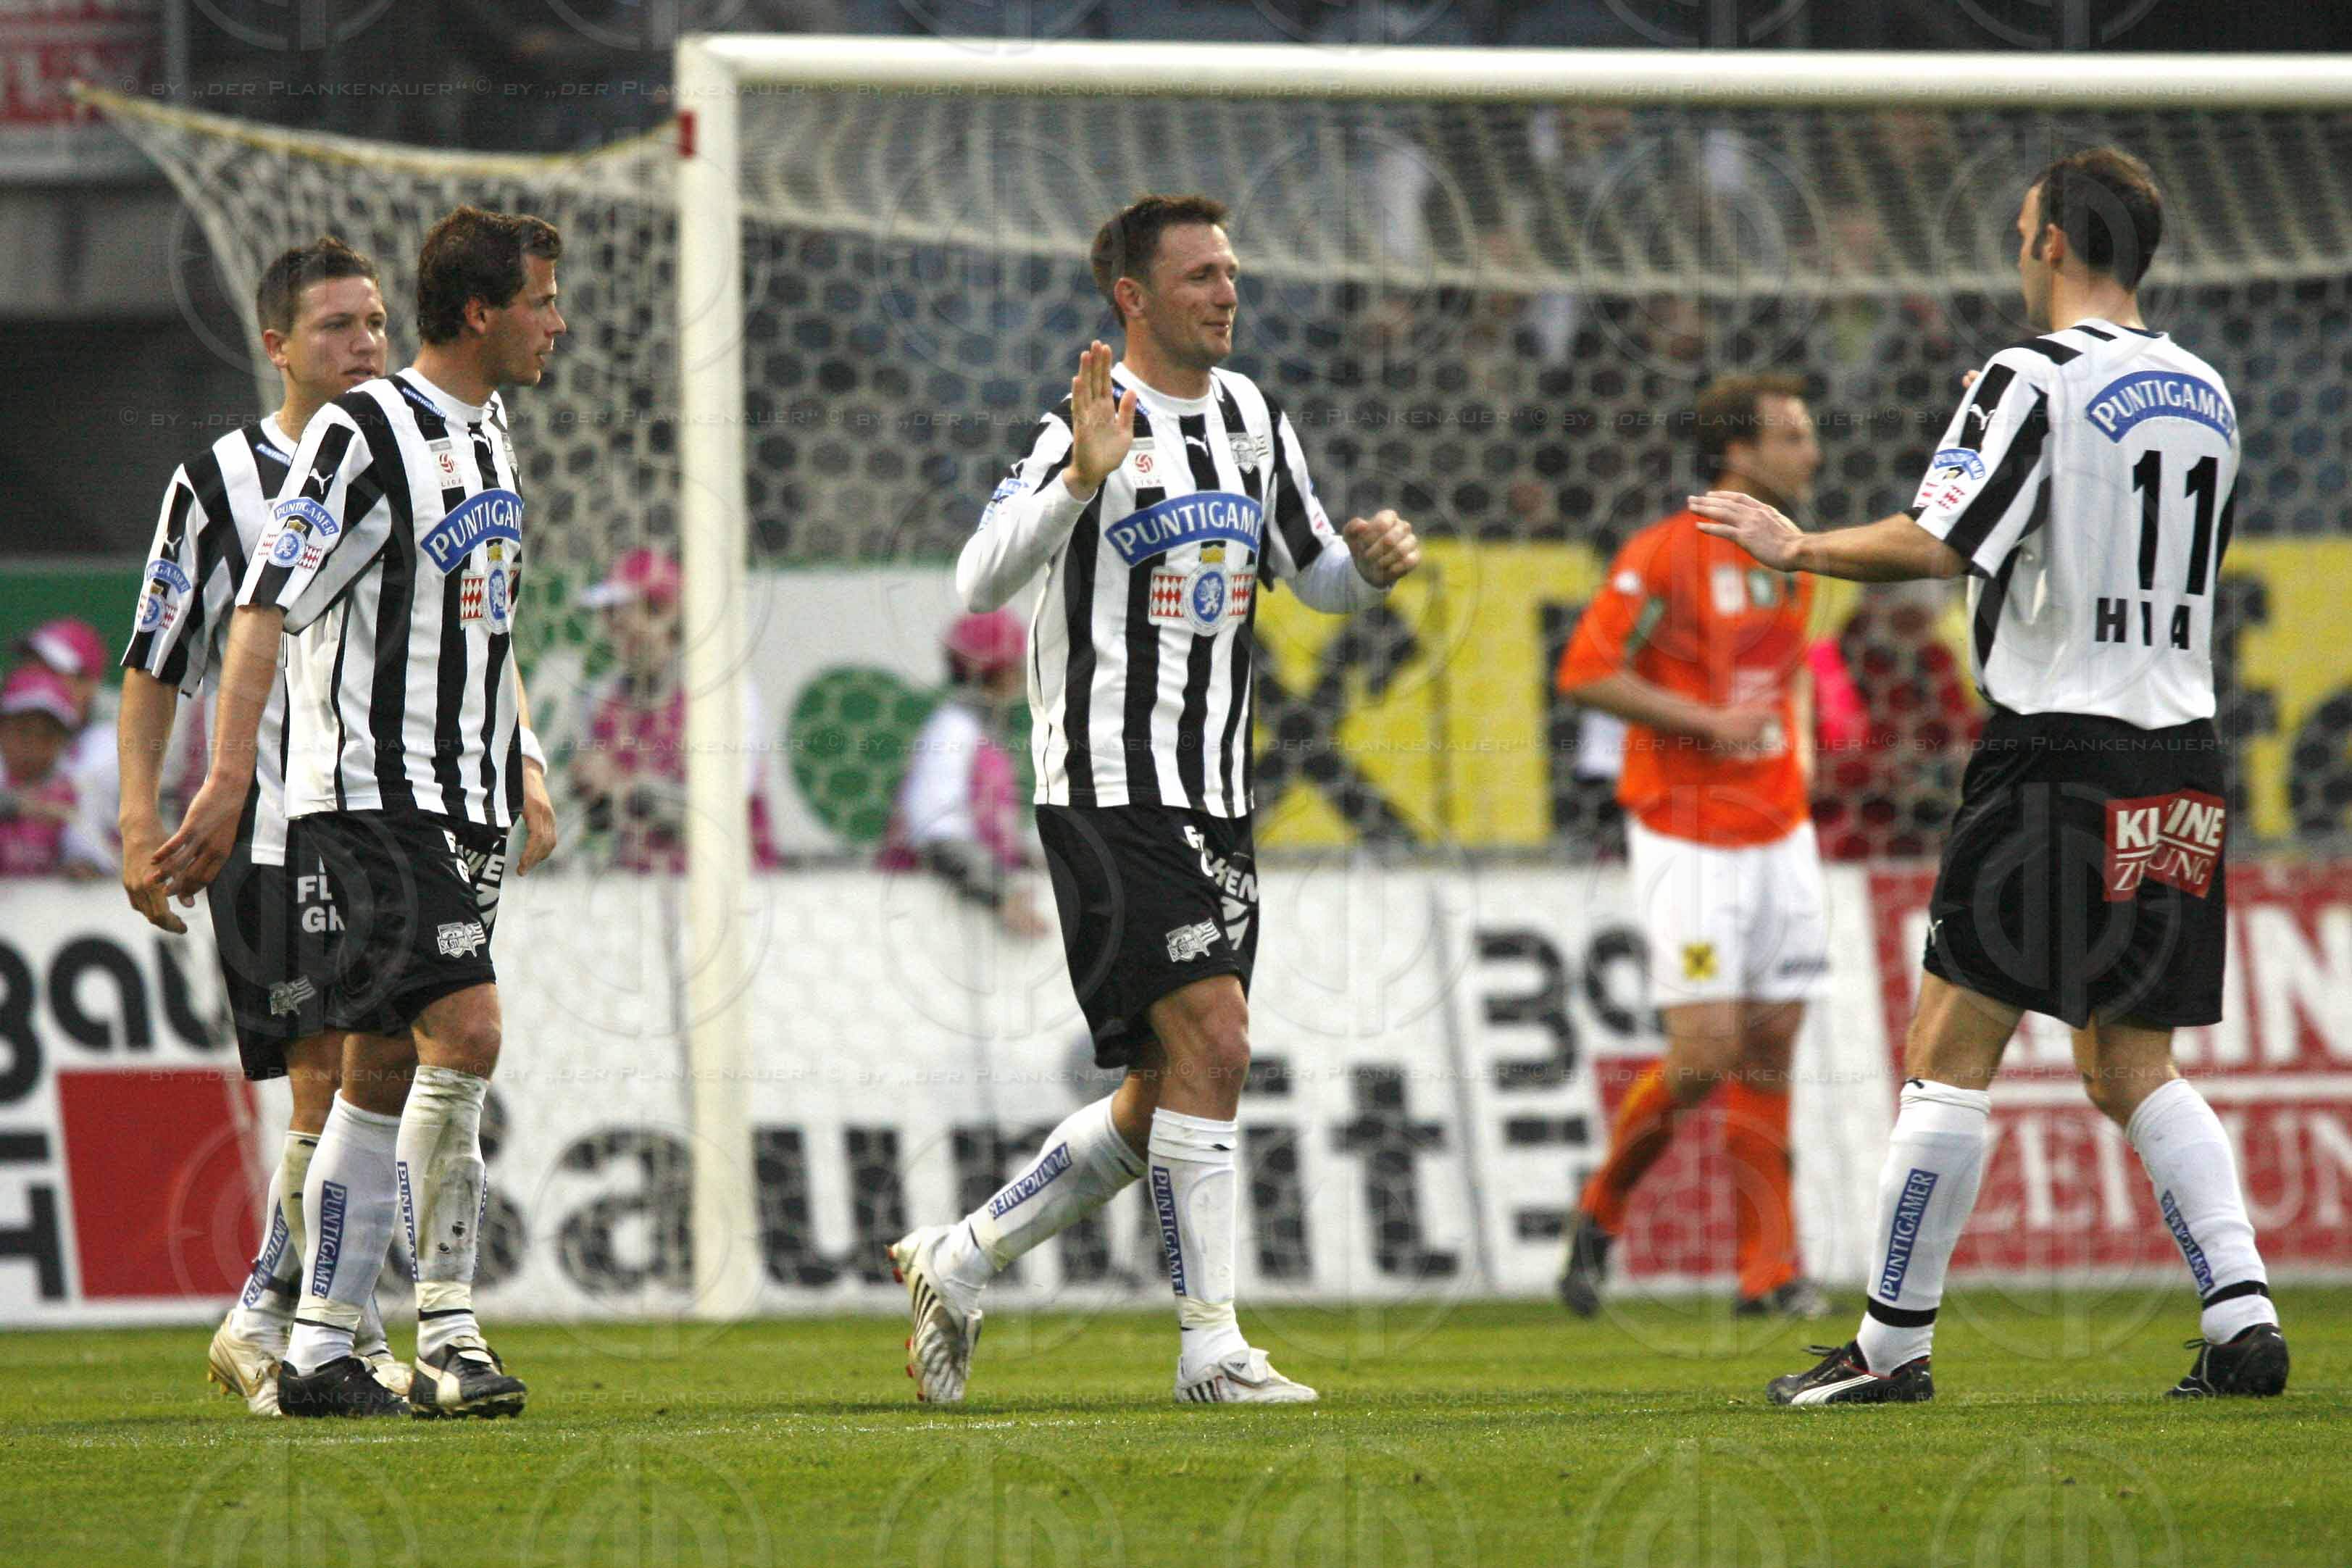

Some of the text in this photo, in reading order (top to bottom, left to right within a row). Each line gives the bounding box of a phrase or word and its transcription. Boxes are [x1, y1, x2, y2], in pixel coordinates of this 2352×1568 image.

[2132, 450, 2217, 596] 11
[244, 1212, 289, 1306] UNTIGAMER
[1880, 1169, 1938, 1301] PUNTIGAMER
